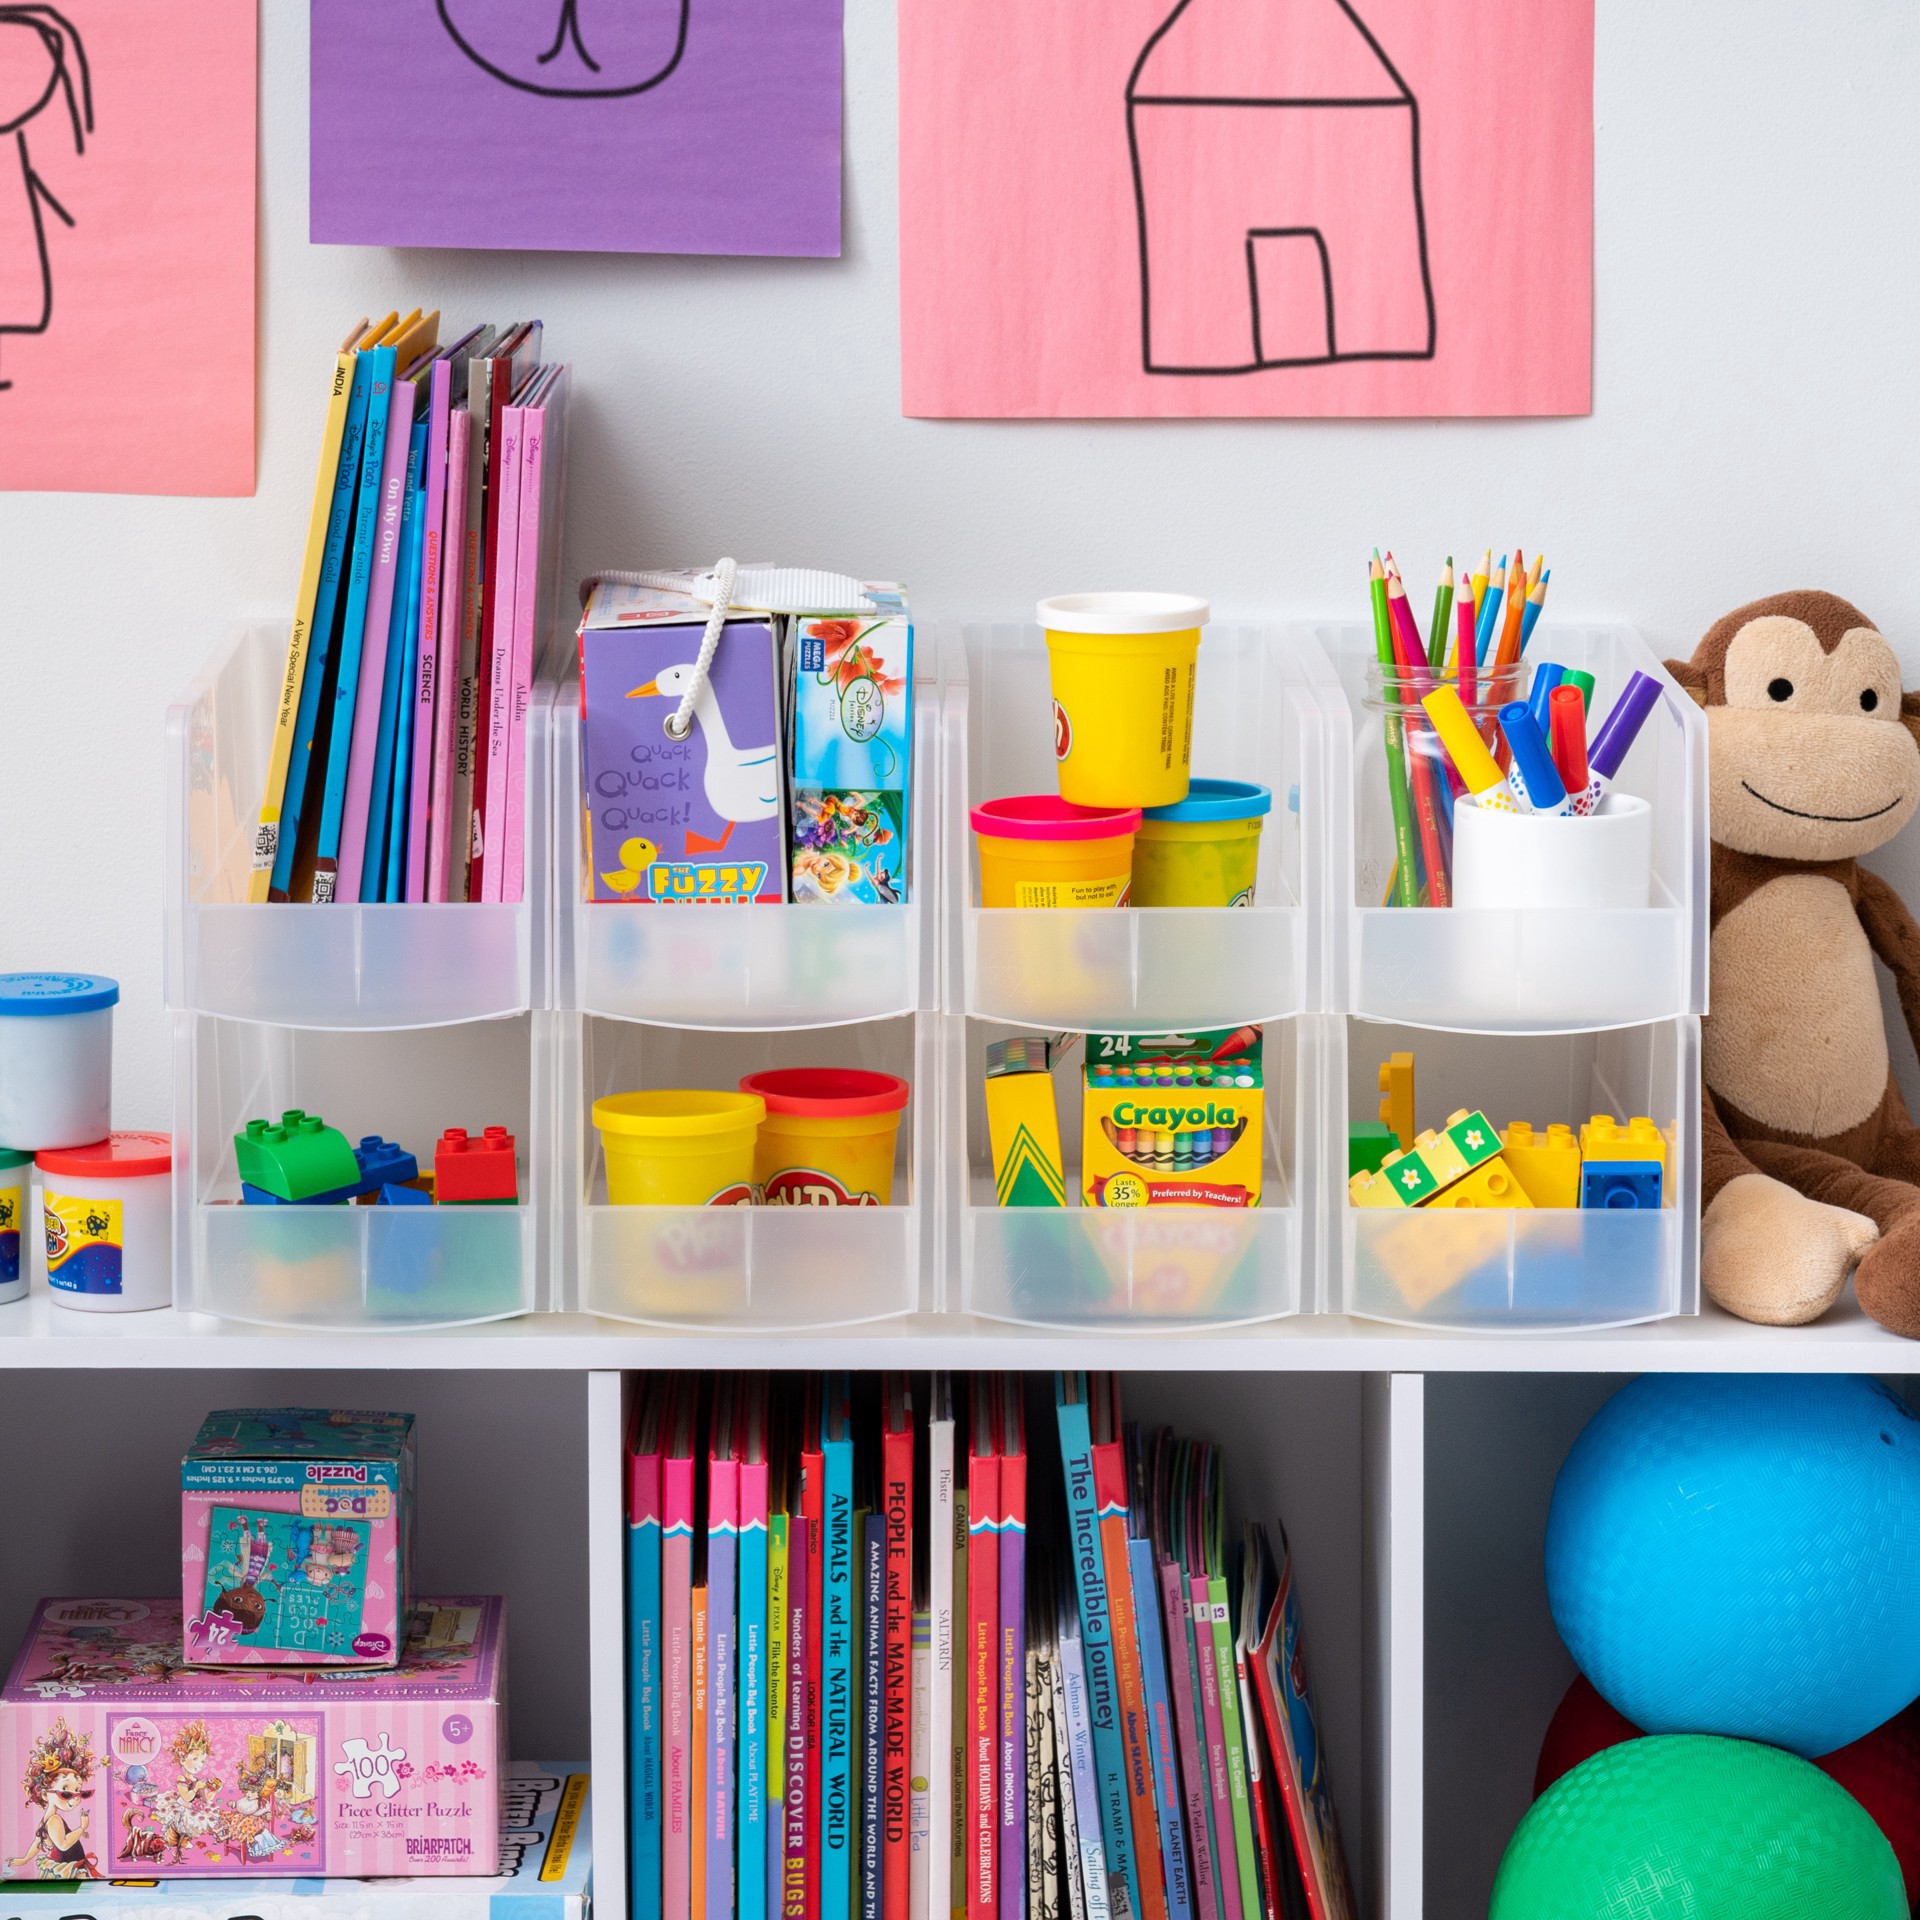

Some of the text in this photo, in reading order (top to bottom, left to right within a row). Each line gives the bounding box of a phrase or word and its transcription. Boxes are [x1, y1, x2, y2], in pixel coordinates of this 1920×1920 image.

[333, 367, 346, 397] INDIA
[364, 460, 379, 489] Pooh
[405, 472, 414, 492] and
[325, 462, 355, 584] Pooh Good as Gold
[380, 477, 400, 564] On My Own
[402, 494, 412, 522] Yetta
[354, 551, 368, 585] Guide
[421, 531, 439, 704] QUESTIONS & ANSWERS SCIENCE
[812, 641, 822, 670] MEGA
[280, 619, 304, 727] A Very Special New Year
[460, 676, 472, 720] WORLD
[492, 648, 506, 757] Dreams Under the Sea
[515, 682, 527, 722] Aladdin
[457, 725, 470, 777] HISTORY
[630, 744, 692, 765] Quack
[594, 767, 690, 799] Quack
[600, 802, 690, 832] Quack!
[652, 863, 765, 895] FUZZY
[672, 867, 690, 875] THE
[1071, 886, 1083, 894] Fun
[1093, 885, 1105, 895] play
[1100, 1034, 1132, 1057] 24
[1113, 1102, 1236, 1131] Crayola
[1112, 1187, 1141, 1200] 35%
[1115, 1178, 1137, 1187] Lasts
[1152, 1189, 1242, 1204] Preferred by Teachers!
[212, 1475, 234, 1484] 9.125
[266, 1476, 295, 1484] 10.375
[306, 1466, 366, 1482] Puzzle
[940, 1469, 951, 1503] Pfister
[324, 1496, 366, 1514] DOC
[888, 1482, 906, 1558] PEOPLE
[810, 1519, 818, 1554] Tallarico
[830, 1493, 848, 1584] ANIMALS
[955, 1504, 965, 1550] CANADA
[1069, 1453, 1113, 1731] The Incredible Journey
[696, 1610, 706, 1642] Vinnie
[1214, 1607, 1225, 1618] 13
[208, 1622, 230, 1645] 24
[792, 1608, 802, 1658] Wonders
[696, 1645, 706, 1676] Takes
[772, 1640, 781, 1659] Flik
[771, 1662, 780, 1675] the
[792, 1663, 802, 1676] of
[1220, 1646, 1234, 1710] Dora the Explorer
[696, 1689, 705, 1711] Bow
[770, 1678, 779, 1720] Inventor
[807, 1682, 815, 1705] LOOK
[886, 1642, 905, 1758] MAN-MADE
[449, 1721, 470, 1737] 5+
[807, 1707, 815, 1728] FOR
[829, 1667, 846, 1762] NATURAL
[866, 1541, 880, 1904] AMAZING ANIMAL FACTS FROM AROUND THE WORLD AND
[1069, 1672, 1088, 1771] Ashman Winter
[119, 1736, 155, 1755] NANCY
[125, 1728, 147, 1737] Fancy
[350, 1754, 390, 1780] 100
[977, 1622, 992, 1904] Little People Big Book About HOLIDAYS and CELEBRATIONS
[1126, 1711, 1146, 1797] About SEASONS
[671, 1746, 682, 1834] About FAMILIES
[716, 1748, 726, 1840] About NATURE
[748, 1741, 758, 1823] About PLAYTIME
[788, 1736, 804, 1848] DISCOVER
[1004, 1741, 1014, 1826] About DINOSAURS
[338, 1801, 472, 1818] Piece Glitter Puzzle
[828, 1773, 845, 1850] WORLD
[886, 1766, 904, 1843] WORLD
[954, 1747, 963, 1857] Donald Joins the Mounties
[1190, 1793, 1201, 1808] My
[911, 1797, 928, 1852] Little Pea
[1191, 1810, 1205, 1842] Perfect
[424, 1855, 441, 1863] 200
[441, 1855, 469, 1863] Awards!
[1168, 1820, 1187, 1905] PLANET EARTH
[1195, 1845, 1209, 1886] Wedding
[786, 1857, 804, 1917] BUGS
[1086, 1847, 1109, 1912] Sailing off
